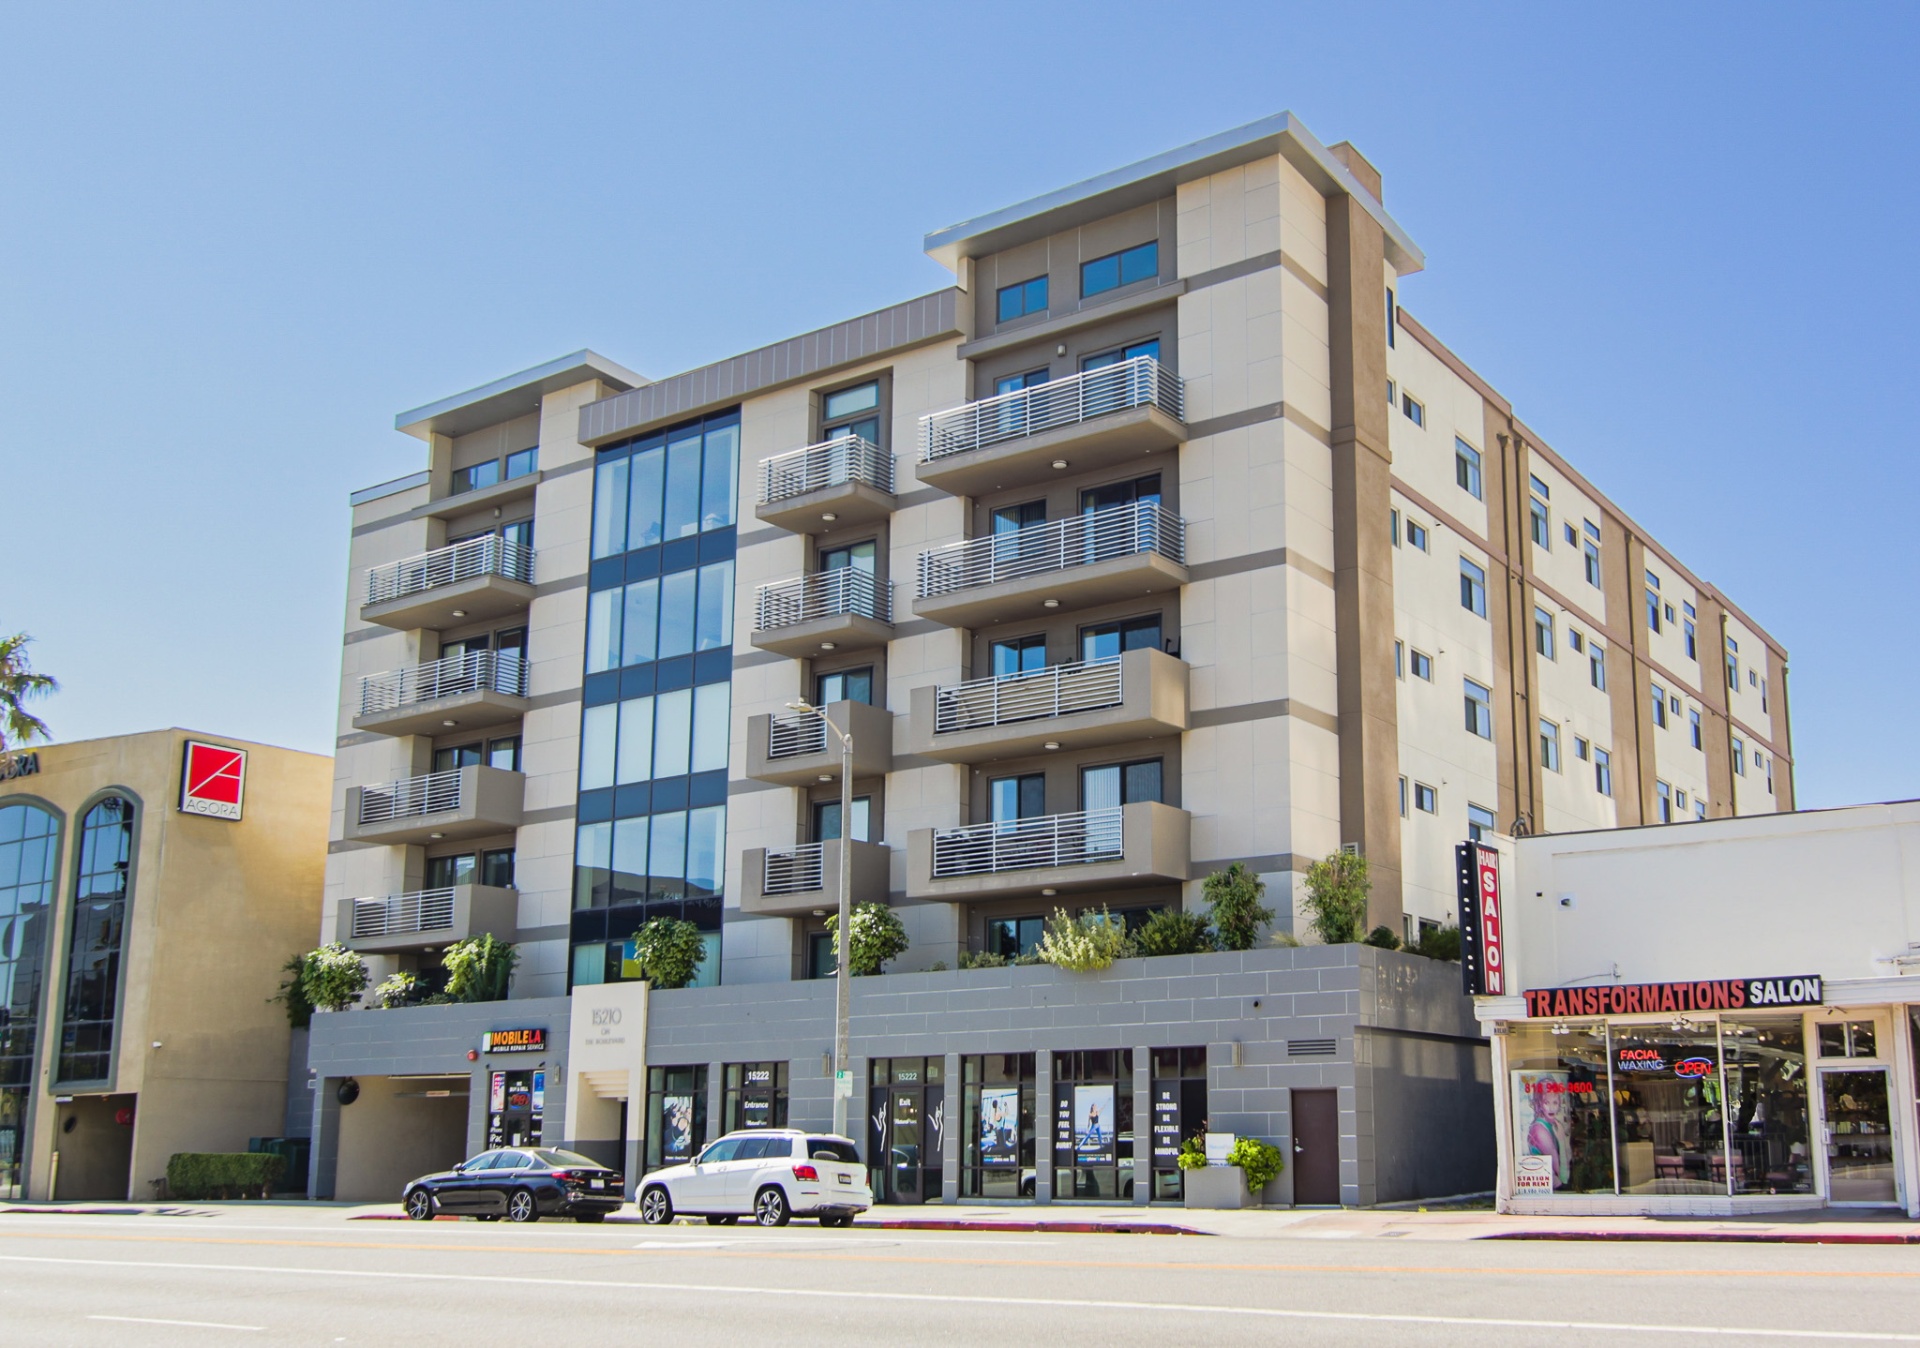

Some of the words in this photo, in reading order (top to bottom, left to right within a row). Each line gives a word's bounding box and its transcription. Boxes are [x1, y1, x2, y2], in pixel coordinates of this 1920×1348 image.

[186, 799, 238, 816] AGORA
[1478, 849, 1498, 868] HAIR
[1483, 870, 1500, 993] SALON
[1523, 980, 1745, 1017] TRANSFORMATIONS
[1750, 978, 1820, 1004] SALON
[592, 1008, 622, 1025] 15210
[1620, 1050, 1661, 1061] FACIAL
[1618, 1059, 1665, 1071] WAXING
[1675, 1061, 1712, 1075] OPEN
[748, 1071, 769, 1080] 15222
[898, 1072, 917, 1080] 15222
[1525, 1082, 1545, 1094] 818
[744, 1101, 769, 1109] Entrance
[1156, 1103, 1177, 1111] STRONG
[1154, 1125, 1179, 1133] FLEXIBLE
[1155, 1147, 1179, 1155] MINDFUL
